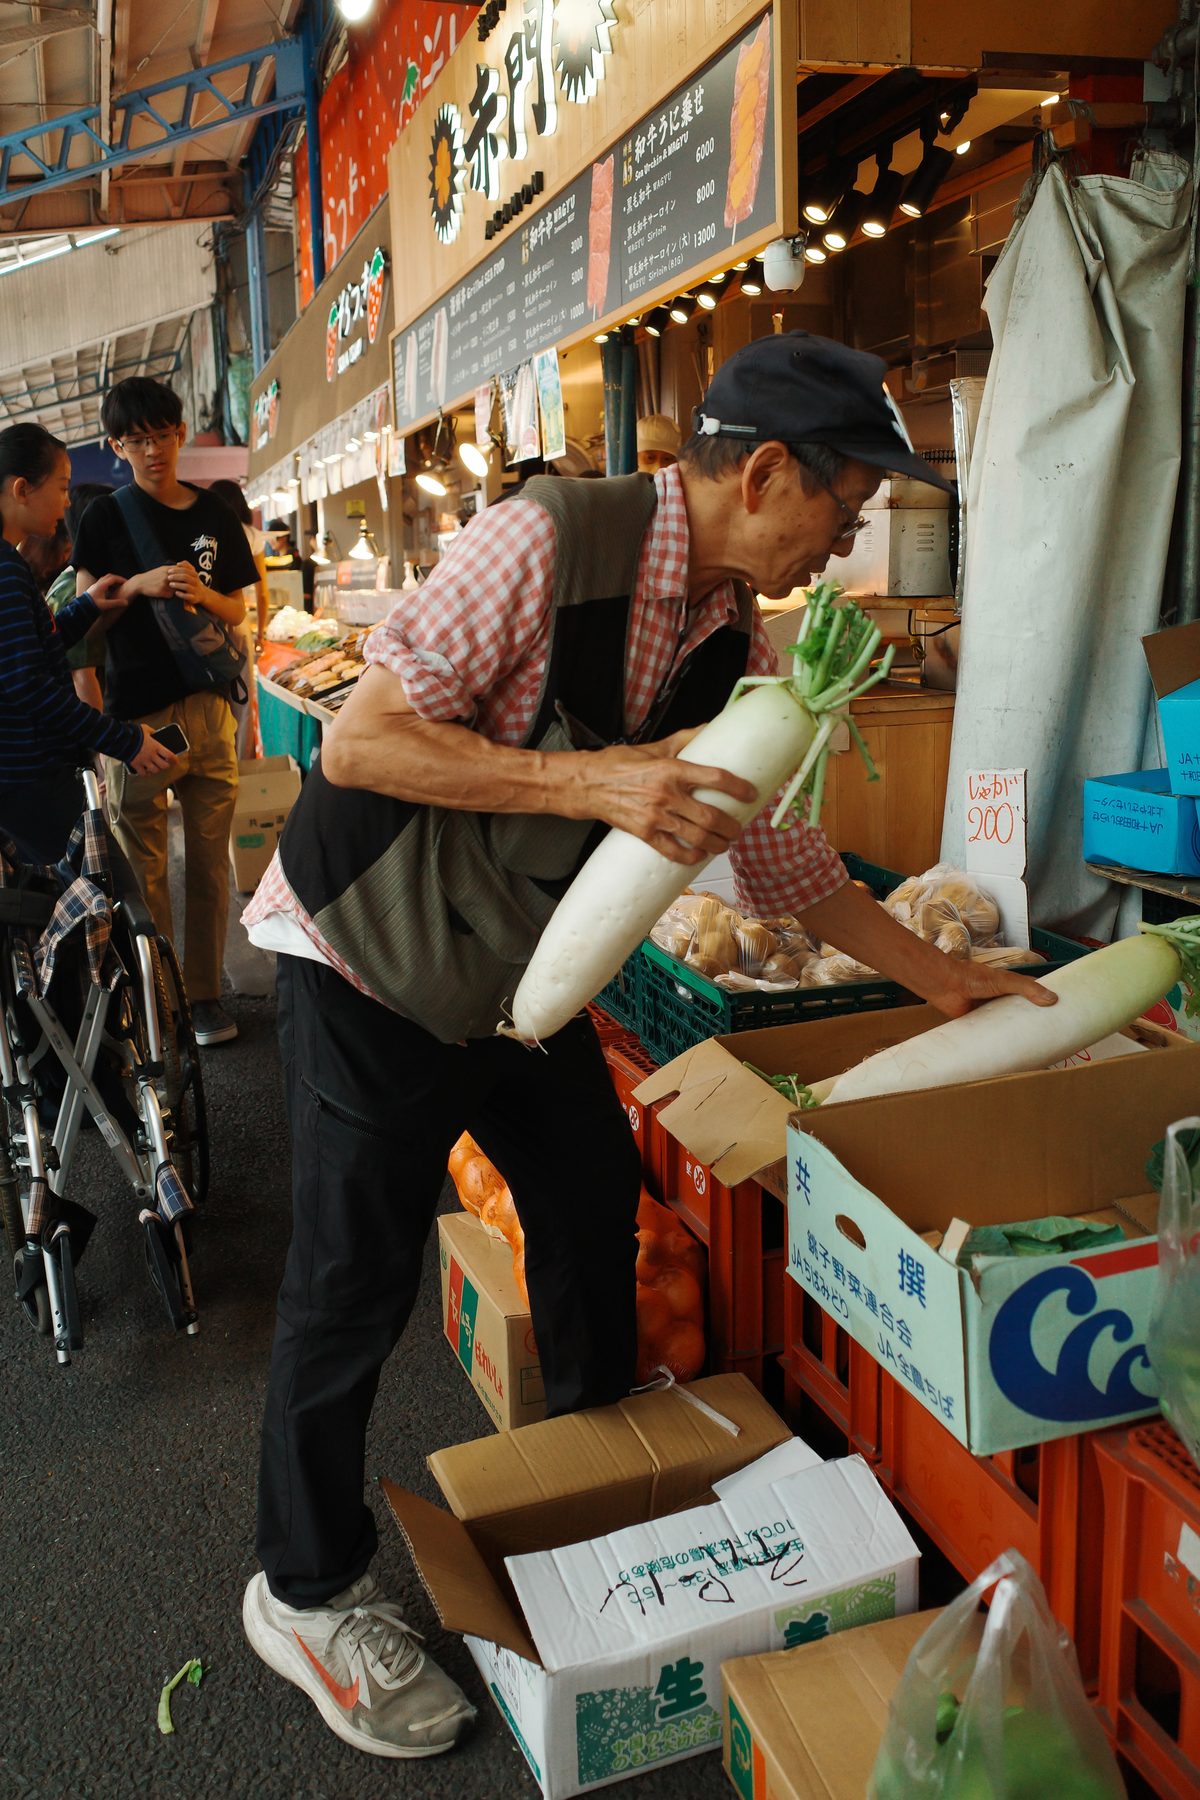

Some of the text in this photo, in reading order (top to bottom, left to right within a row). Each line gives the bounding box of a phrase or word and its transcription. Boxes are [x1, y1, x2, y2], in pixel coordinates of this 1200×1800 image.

[635, 84, 704, 163] 和牛うに乗せ
[623, 156, 633, 187] A5
[626, 137, 714, 214] 黒毛和牛 WAGYU 6000
[635, 169, 644, 181] Sea
[667, 130, 689, 156] WAGYU
[553, 194, 576, 224] WAGYU
[627, 180, 715, 241] 黒毛和牛サーロイン 8000
[571, 235, 583, 254] 3000
[647, 224, 667, 242] Sirloin
[693, 222, 716, 248] 13000
[493, 257, 505, 277] FOOD
[571, 266, 583, 285] 5000
[570, 301, 585, 320] 10000
[968, 774, 1019, 800] じゃが
[967, 802, 1014, 845] 200
[796, 1156, 811, 1205] 共
[791, 1242, 850, 1320] JAちばみどり
[807, 1229, 913, 1350] 銚子野菜連合会
[876, 1332, 955, 1420] JA全農ちば
[654, 1655, 709, 1721] 生
